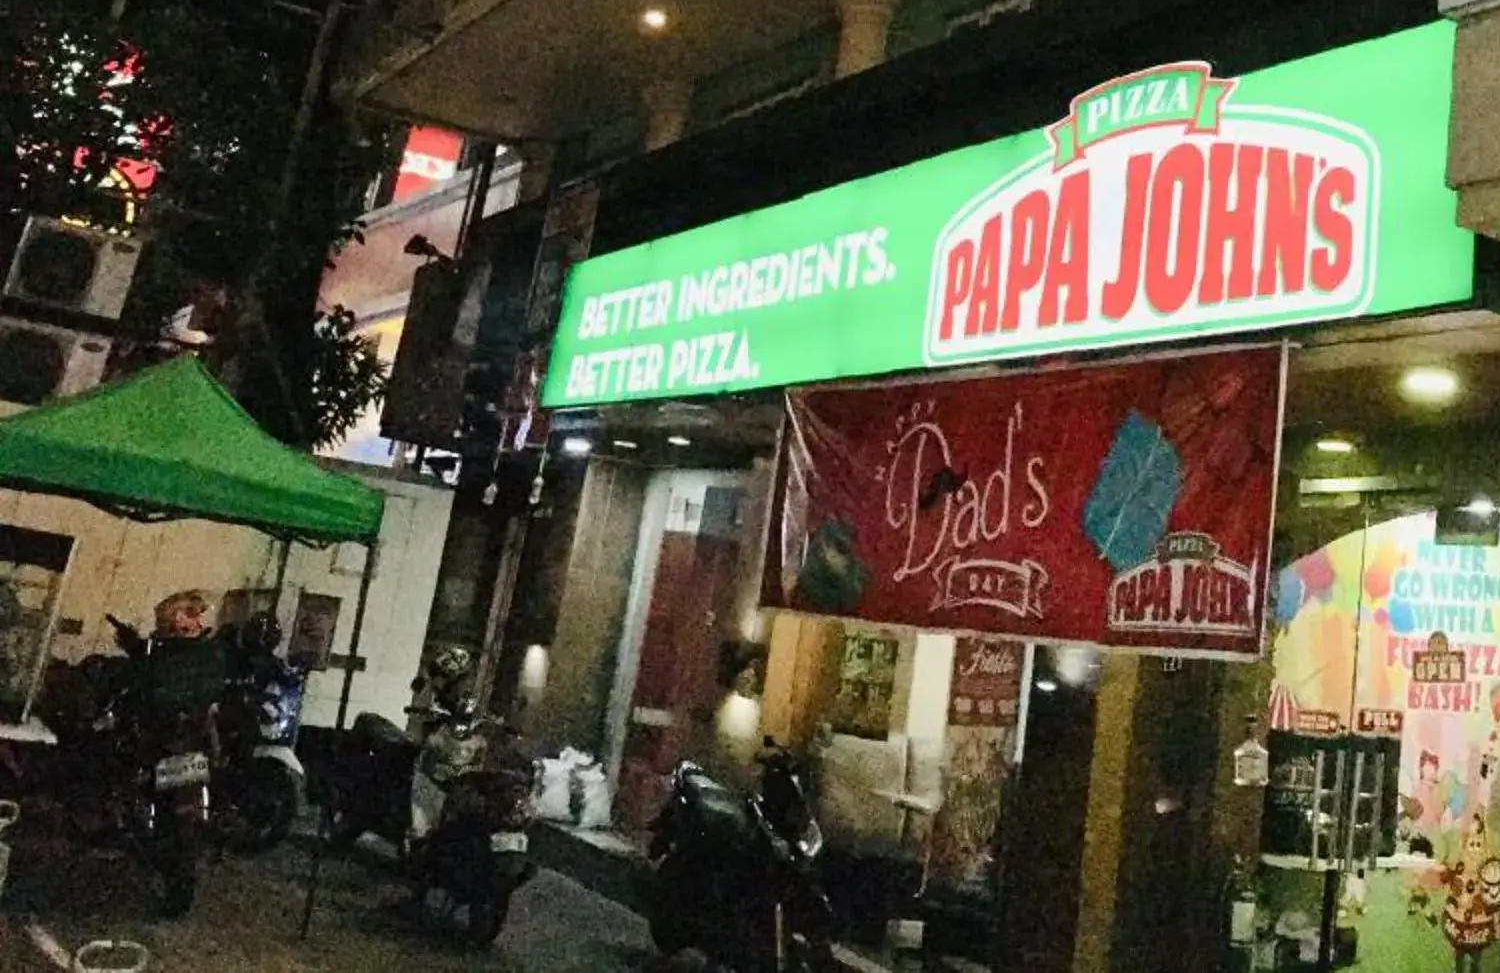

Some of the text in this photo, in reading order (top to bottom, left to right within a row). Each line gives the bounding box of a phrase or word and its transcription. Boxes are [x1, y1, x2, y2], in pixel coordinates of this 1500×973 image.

[1087, 77, 1188, 134] PIZZA
[939, 142, 1355, 341] PAPA JOHN'S
[578, 226, 897, 340] BETTER INGREDIENTS.
[565, 329, 760, 399] BETTER PIZZA.
[885, 400, 1049, 583] Dad's
[1394, 570, 1423, 599] GO
[1414, 605, 1496, 634] WITH A
[1407, 681, 1483, 714] BASH!
[1415, 661, 1462, 681] OPEN
